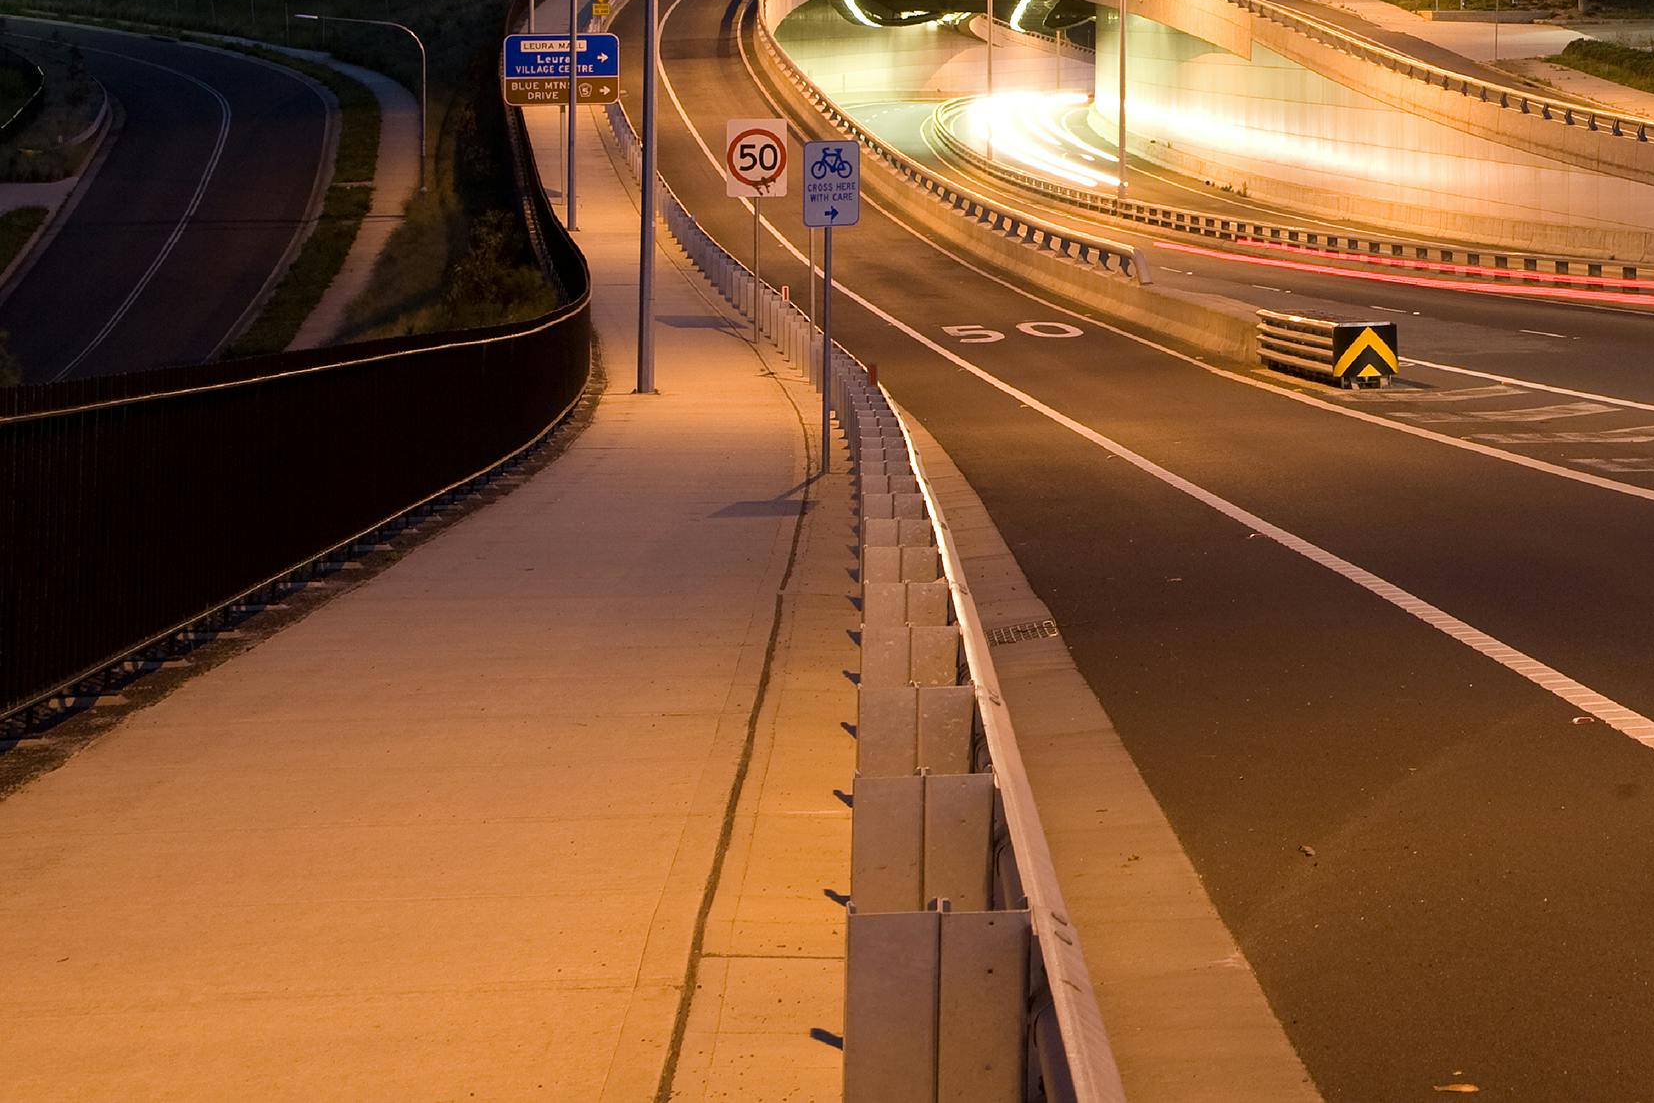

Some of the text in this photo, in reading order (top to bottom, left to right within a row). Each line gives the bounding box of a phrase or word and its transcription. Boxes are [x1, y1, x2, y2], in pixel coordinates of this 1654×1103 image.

[558, 42, 584, 50] MAL
[537, 55, 570, 64] Leura
[515, 64, 594, 74] VILLAGE CETRE
[511, 82, 540, 91] BLUE
[527, 92, 559, 100] DRIVE
[739, 143, 778, 171] 50
[807, 182, 856, 192] CROSS HERE
[810, 192, 853, 202] WITH CARE
[941, 321, 1084, 343] 50
